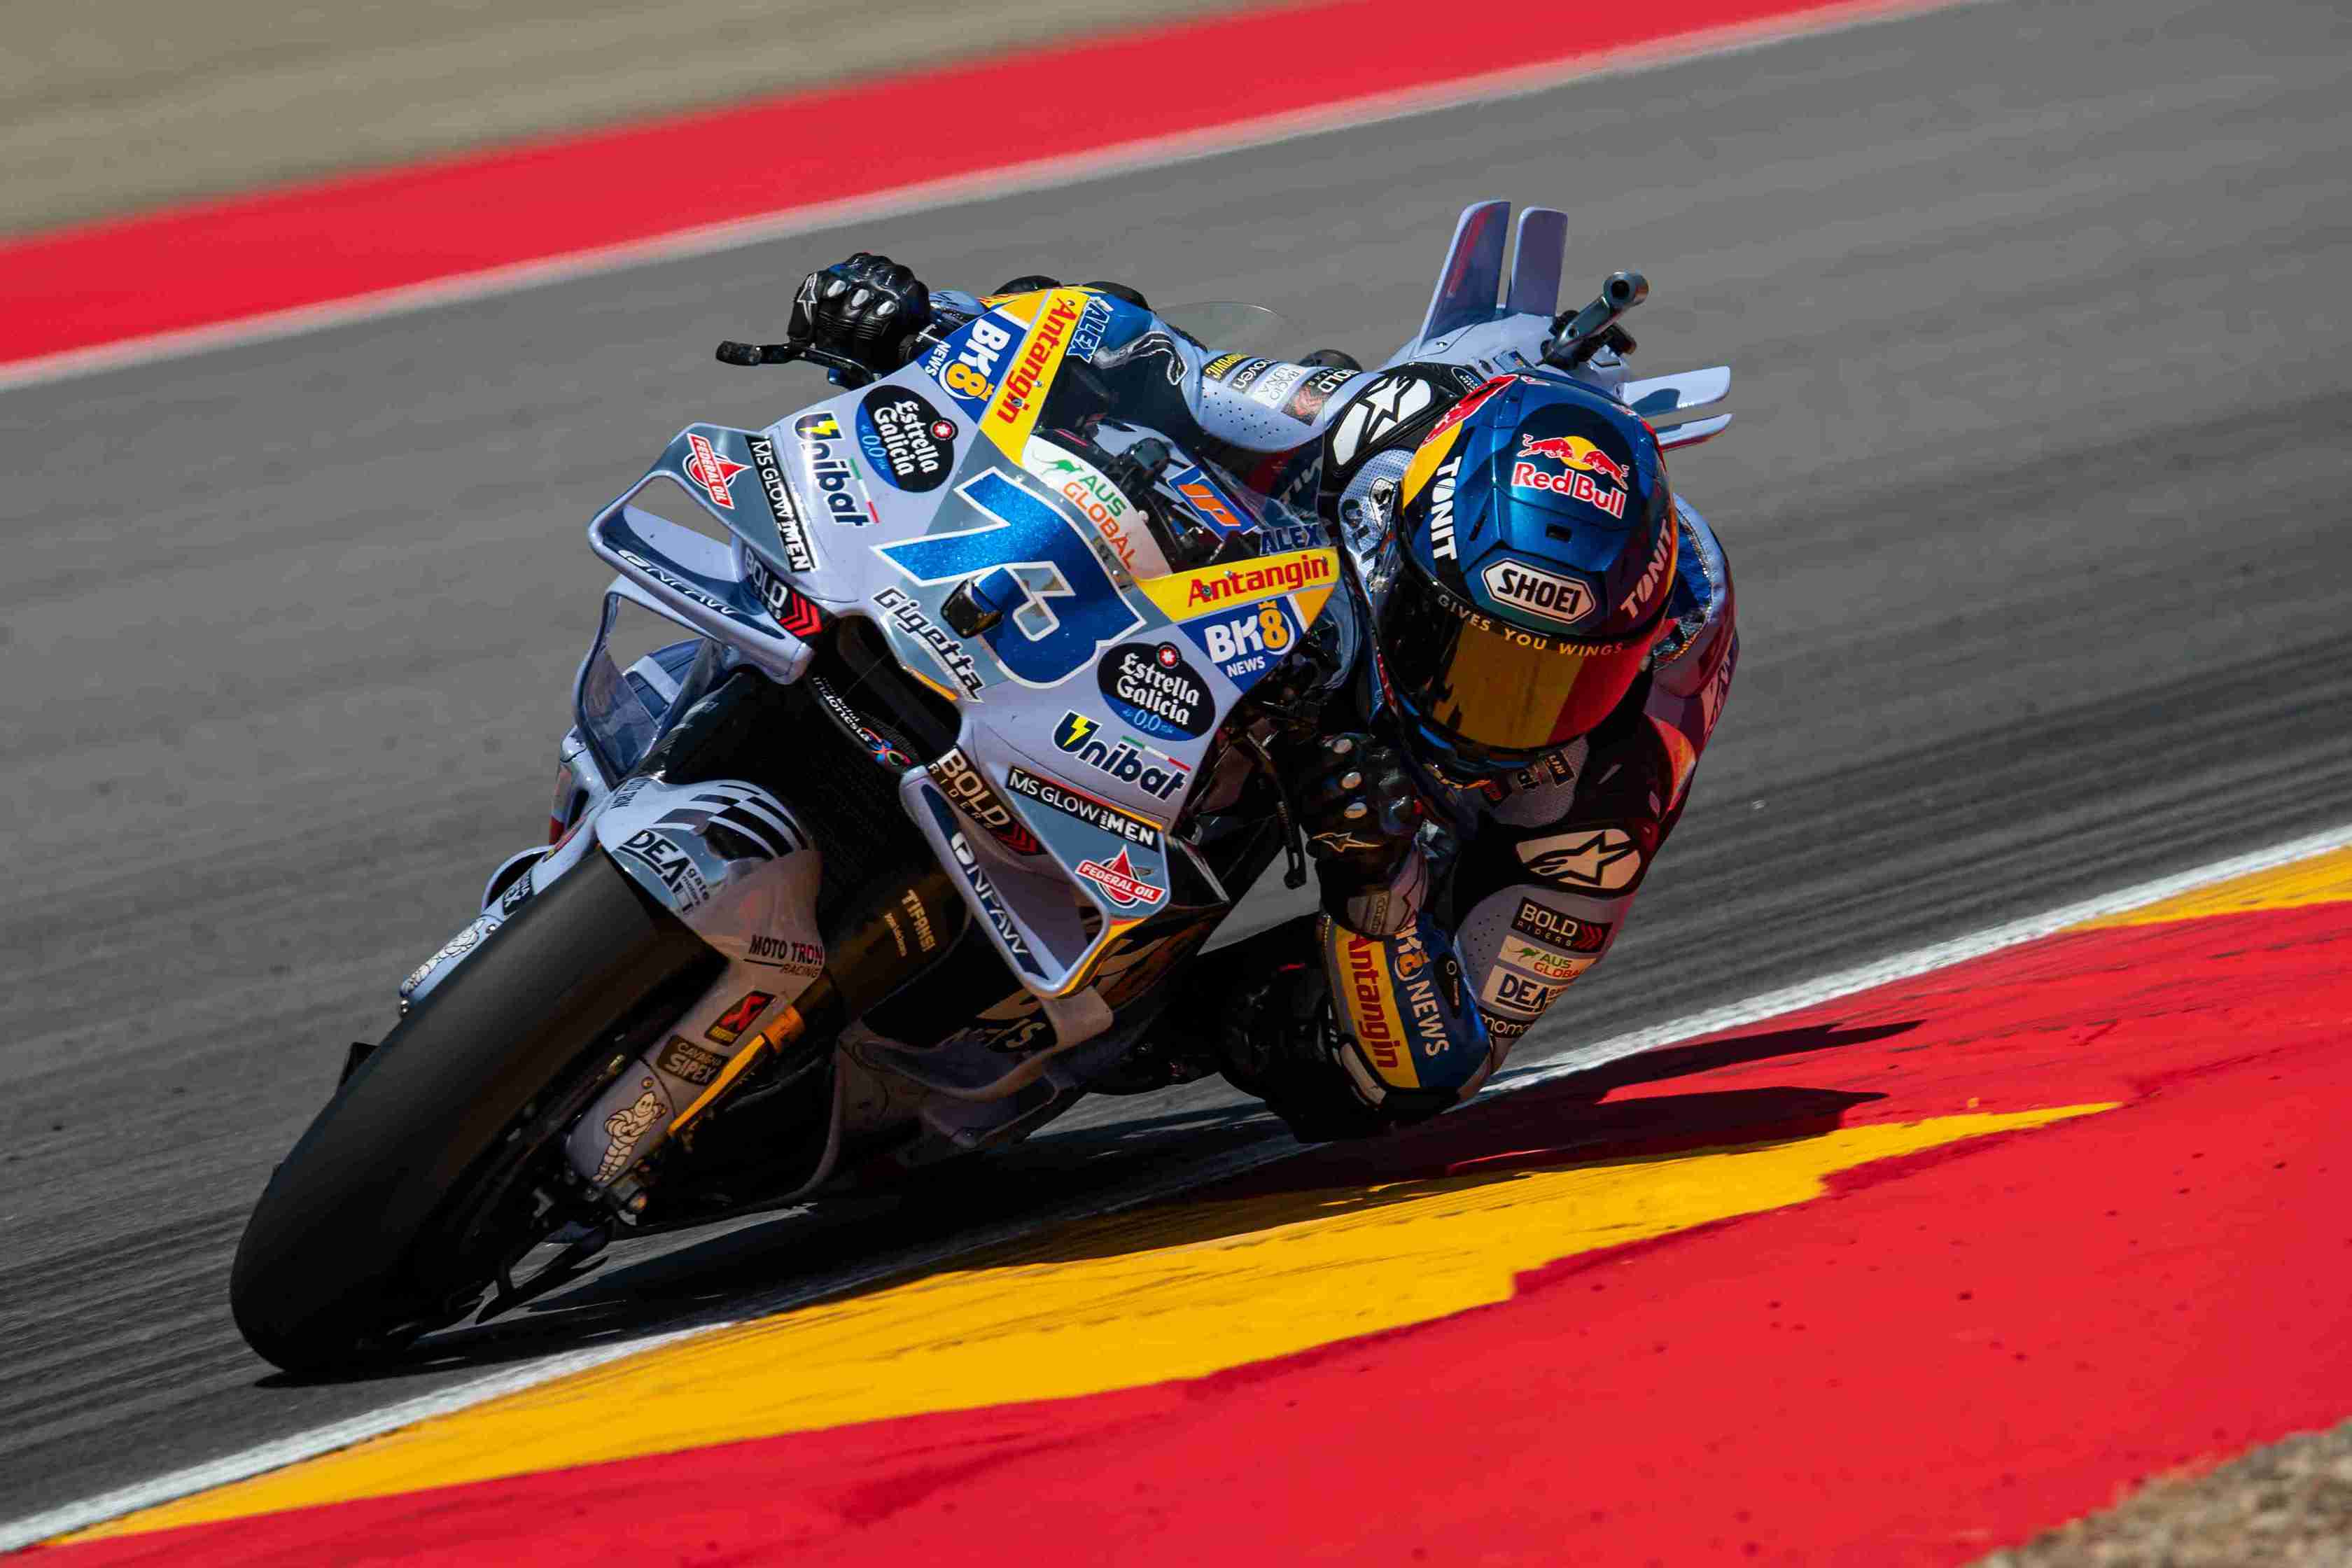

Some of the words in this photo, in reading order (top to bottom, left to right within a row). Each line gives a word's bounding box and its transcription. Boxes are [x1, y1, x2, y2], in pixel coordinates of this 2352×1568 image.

[925, 341, 951, 377] NEWS
[941, 318, 1011, 401] BK8
[997, 298, 1078, 424] Antangin
[1066, 301, 1111, 363] ALEX
[751, 439, 774, 465] MS
[874, 407, 914, 476] Galicia
[893, 400, 939, 474] Estrella
[694, 435, 720, 485] FEDERAL
[712, 485, 729, 503] OIL
[762, 467, 793, 521] GLOW
[794, 412, 872, 526] Unibat
[1079, 474, 1128, 517] AUS
[1511, 461, 1574, 496] Red
[1574, 472, 1626, 519] Bull
[1063, 481, 1139, 570] GLOBAL
[1431, 456, 1462, 560] TONIT
[784, 525, 811, 570] MEN
[1261, 524, 1322, 555] ALEX
[1620, 518, 1674, 619] TONIT
[745, 547, 788, 608] BOLD
[1188, 554, 1329, 608] Antangin
[1497, 568, 1581, 615] SHOEI
[872, 587, 984, 701] Gigetta
[1204, 602, 1295, 664] BK8
[1437, 594, 1491, 632] GIVES
[1504, 626, 1548, 651] YOU
[1559, 642, 1623, 657] WINGS
[1119, 652, 1200, 707] Estrella
[1226, 655, 1266, 678] NEWS
[1116, 676, 1191, 726] Galicia
[1053, 710, 1187, 801] Unibat
[938, 749, 1009, 826] BOLD
[1009, 771, 1038, 795] MS
[1040, 785, 1099, 822] GLOW
[1107, 812, 1154, 846] MEN
[623, 830, 690, 888] DEA
[1084, 863, 1133, 892] FEDERAL
[1133, 884, 1155, 900] OIL
[1517, 920, 1572, 946] RIDERS
[1520, 902, 1578, 937] BOLD
[748, 934, 787, 959] MOTO
[792, 941, 824, 966] TRON
[1540, 953, 1573, 969] AUS
[1348, 934, 1401, 1068] Antangin
[1406, 980, 1450, 1057] NEWS
[1497, 973, 1548, 1011] DEA
